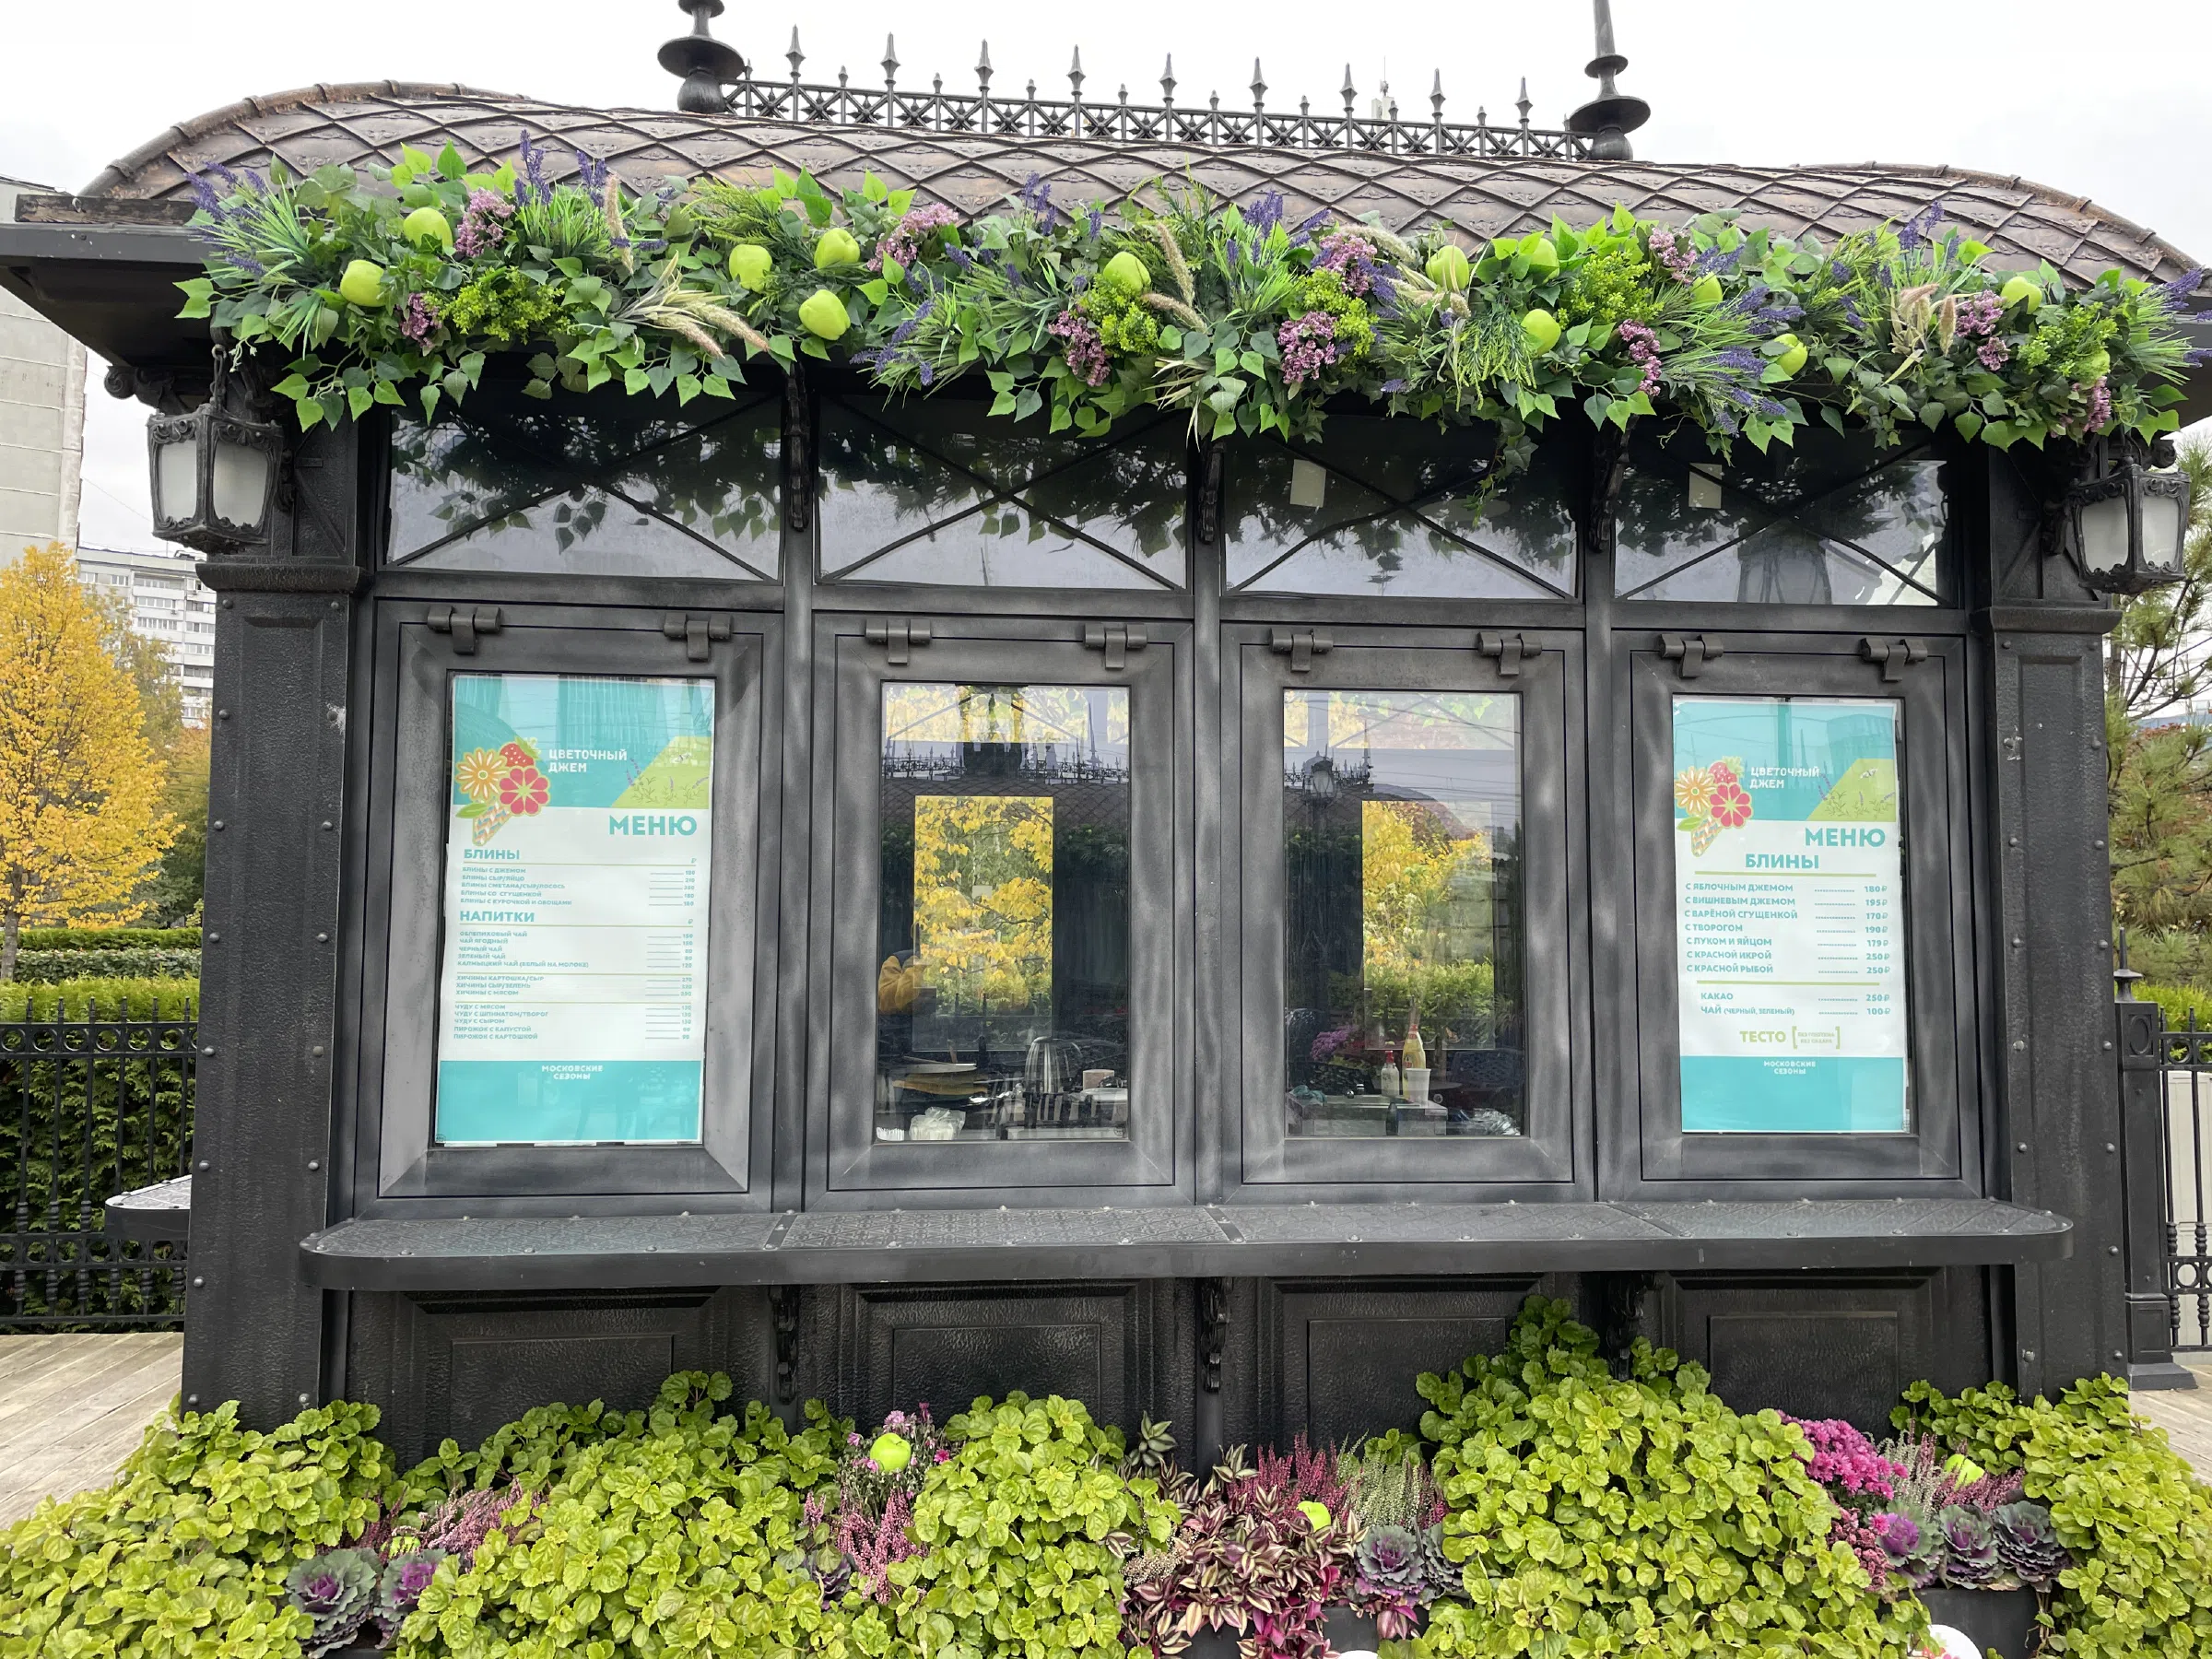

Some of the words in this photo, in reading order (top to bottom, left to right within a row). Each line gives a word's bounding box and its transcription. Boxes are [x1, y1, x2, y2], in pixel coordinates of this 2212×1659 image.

[548, 748, 627, 761] ЦВЕТОЧНЫЙ
[547, 763, 587, 774] ДЖЕМ
[1751, 767, 1819, 777] ЦВЕТОЧНЫЙ
[1749, 780, 1784, 789] ДЖЕМ
[609, 815, 697, 836] МЕНЮ
[1805, 828, 1885, 847] МЕНЮ
[464, 849, 520, 860] БЛИНЫ
[1745, 854, 1819, 868] БЛИНЫ
[1747, 884, 1793, 893] ДЖЕМОМ
[1693, 897, 1747, 905] ВИШНЕВЫМ
[1749, 898, 1795, 906] ДЖЕМОМ
[460, 911, 535, 922] НАПИТКИ
[1692, 909, 1735, 918] ВАРЁНОЙ
[1738, 910, 1797, 921] СГУЩЕНКОЙ
[1693, 924, 1743, 932] ТВОРОГОМ
[1694, 937, 1726, 946] ЛУКОМ
[1737, 936, 1772, 947] ЯЙЦОМ
[1695, 950, 1737, 959] КРАСНОЙ
[1740, 950, 1771, 959] ИКРОЙ
[1695, 964, 1738, 972] КРАСНОЙ
[1741, 964, 1773, 973] РЫБОЙ
[1700, 1004, 1721, 1014] ЧАЙ
[1740, 1030, 1786, 1042] ТЕСТО
